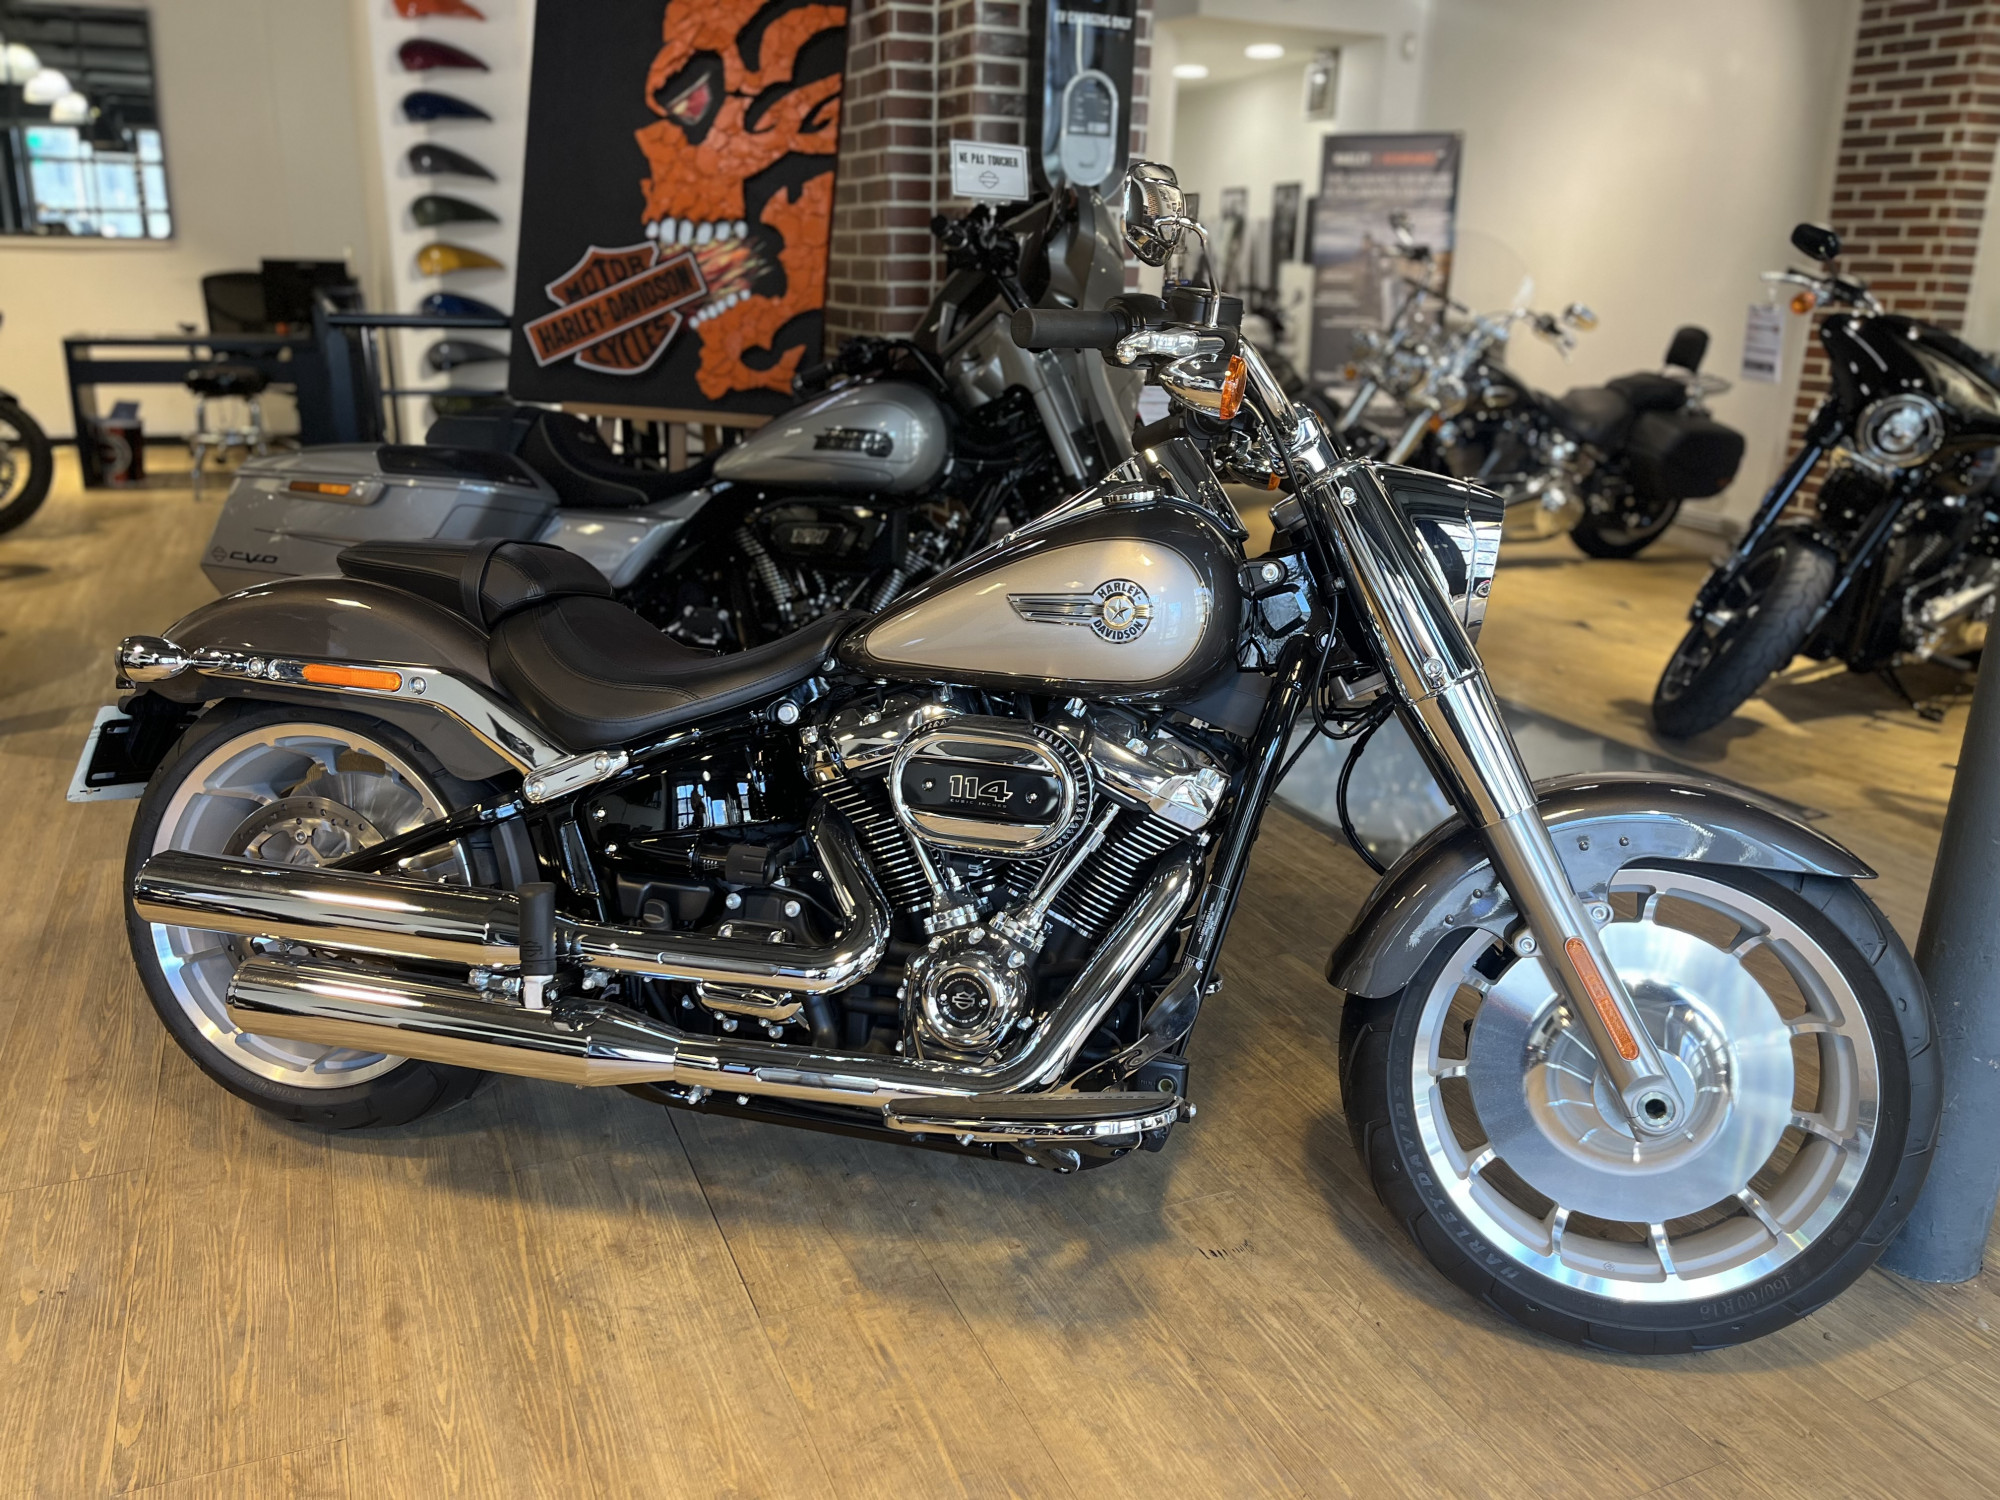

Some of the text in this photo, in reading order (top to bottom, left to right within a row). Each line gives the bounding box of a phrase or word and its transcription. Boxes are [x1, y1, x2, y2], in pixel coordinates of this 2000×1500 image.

[959, 152, 1019, 168] NE PAS TOUCHER
[564, 256, 647, 300] MOTOR
[536, 264, 694, 353] HARLEY-DAVIDSON
[591, 314, 670, 368] CYCLES
[229, 551, 278, 564] CVO
[1097, 582, 1142, 601] HARLEY-
[1093, 618, 1144, 640] DAVIDSON
[949, 775, 1014, 803] 114
[950, 798, 974, 806] CUBIC
